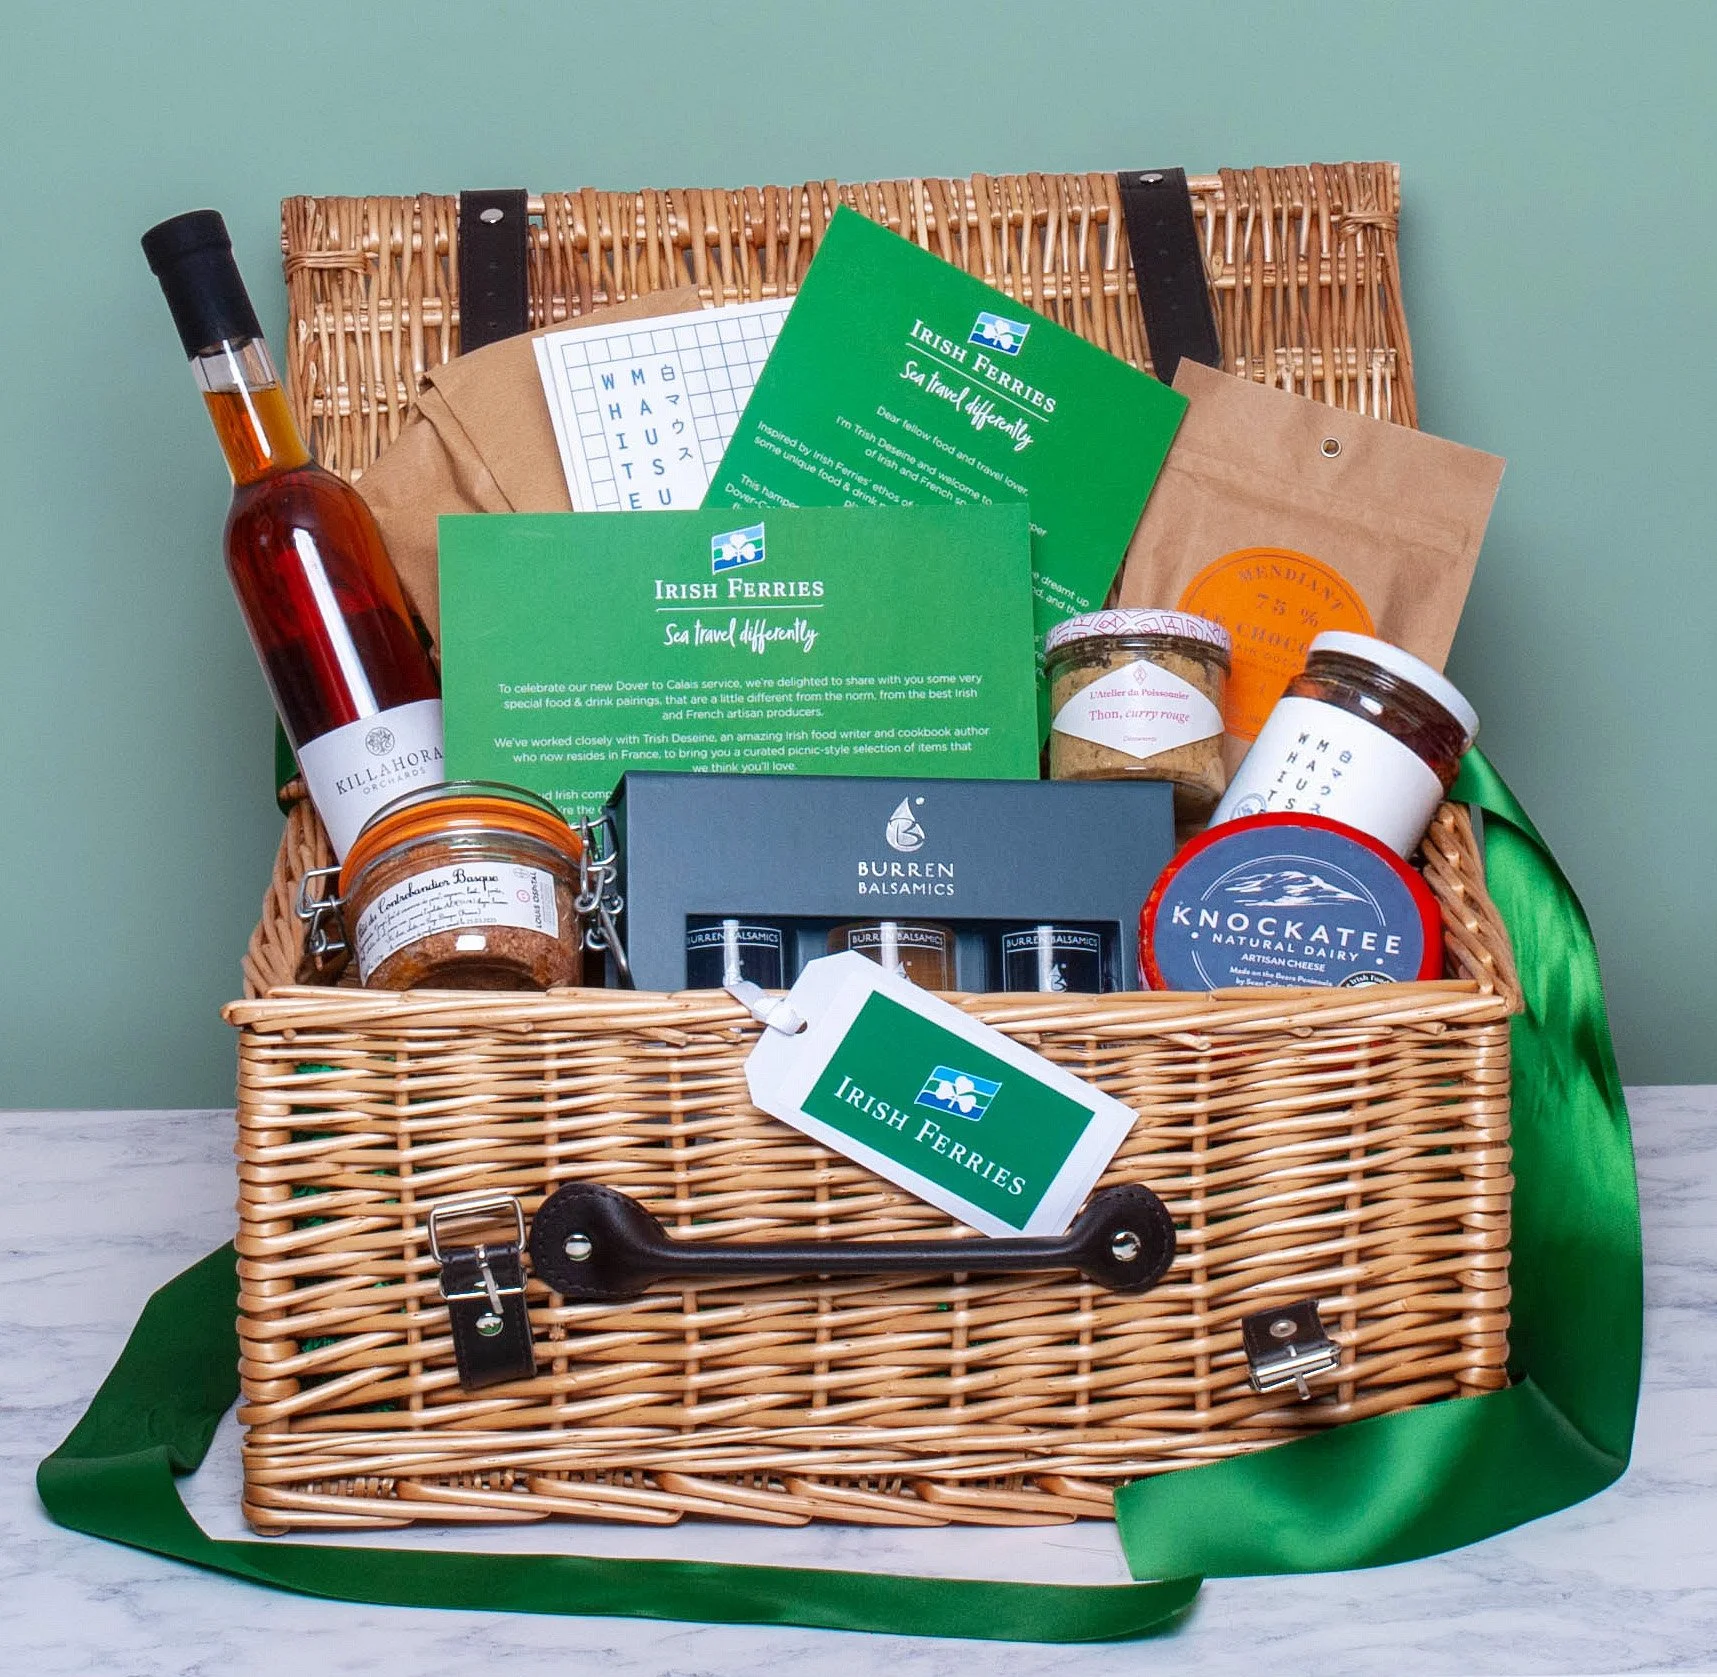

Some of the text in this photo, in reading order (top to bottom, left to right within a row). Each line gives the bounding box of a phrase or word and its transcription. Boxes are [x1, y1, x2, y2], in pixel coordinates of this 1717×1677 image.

[900, 361, 1033, 451] Sea travel differently
[876, 406, 1003, 482] Dear fellow food and travel
[754, 436, 781, 455] some
[783, 451, 816, 474] unique
[817, 468, 842, 487] food
[842, 480, 850, 492] &
[852, 486, 877, 506] drink
[757, 421, 798, 448] Inspired
[798, 442, 812, 456] by
[813, 450, 834, 468] Irish
[872, 480, 900, 503] ethos
[854, 424, 876, 443] Trish
[877, 438, 916, 465] Deseine
[917, 460, 937, 476] and
[939, 471, 980, 499] welcome
[982, 495, 993, 507] to
[740, 473, 760, 492] This
[865, 448, 876, 459] of
[877, 453, 898, 470] Irish
[899, 467, 920, 482] and
[919, 476, 953, 501] French
[1041, 576, 1076, 600] dreamt
[1076, 595, 1090, 609] up
[1046, 594, 1066, 609] and
[663, 617, 819, 655] Sea travel differently
[499, 684, 512, 694] To
[514, 682, 566, 694] celebrate
[568, 684, 587, 693] our
[589, 683, 613, 693] new
[616, 681, 649, 692] Dover
[651, 681, 664, 691] to
[666, 678, 699, 690] Calais
[745, 677, 775, 688] we're
[777, 676, 829, 689] delighted
[831, 676, 843, 686] to
[845, 674, 875, 686] share
[877, 674, 901, 686] with
[904, 675, 924, 687] you
[927, 674, 957, 684] some
[959, 673, 983, 685] very
[503, 697, 544, 711] special
[546, 697, 571, 708] food
[574, 697, 583, 707] &
[585, 696, 613, 707] drink
[665, 694, 687, 705] that
[690, 696, 708, 705] are
[720, 693, 744, 704] little
[747, 692, 793, 704] different
[796, 691, 821, 702] from
[824, 691, 843, 702] the
[879, 690, 905, 701] from
[908, 690, 926, 700] the
[928, 689, 952, 700] best
[955, 688, 978, 699] Irish
[662, 706, 824, 721] and French artisan producers.
[1089, 709, 1190, 724] Thon, curry rouge
[494, 736, 528, 748] We've
[531, 735, 572, 747] worked
[574, 734, 613, 748] closely
[615, 734, 640, 745] with
[643, 733, 669, 744] Trish
[720, 733, 734, 743] an
[737, 731, 783, 744] amazing
[785, 729, 809, 740] Irish
[811, 728, 837, 740] food
[839, 728, 870, 740] writer
[874, 728, 895, 739] and
[897, 726, 951, 738] cookbook
[953, 726, 990, 737] author
[513, 751, 537, 762] who
[539, 752, 563, 762] now
[566, 750, 605, 761] resides
[608, 750, 618, 760] in
[664, 748, 676, 758] to
[679, 747, 708, 760] bring
[711, 748, 731, 759] you
[744, 745, 785, 757] curated
[787, 743, 850, 758] picnic-style
[853, 742, 901, 754] selection
[903, 742, 915, 753] of
[918, 742, 947, 752] items
[950, 741, 972, 751] that
[335, 746, 443, 795] KILLAHORA
[692, 764, 709, 773] we
[711, 762, 738, 773] think
[741, 762, 770, 773] you'll
[362, 766, 426, 796] ORCHARDS
[555, 790, 578, 800] Irish
[577, 805, 595, 815] the
[858, 861, 954, 878] BURREN
[858, 881, 955, 896] BALSAMICS
[897, 932, 943, 946] BALSAMICS
[1172, 905, 1402, 955] KNOCKATEE
[1051, 935, 1098, 947] BALSAMICS
[1212, 933, 1359, 962] NATURAL DAIRY
[1241, 953, 1326, 973] ARTISAN CHEESE
